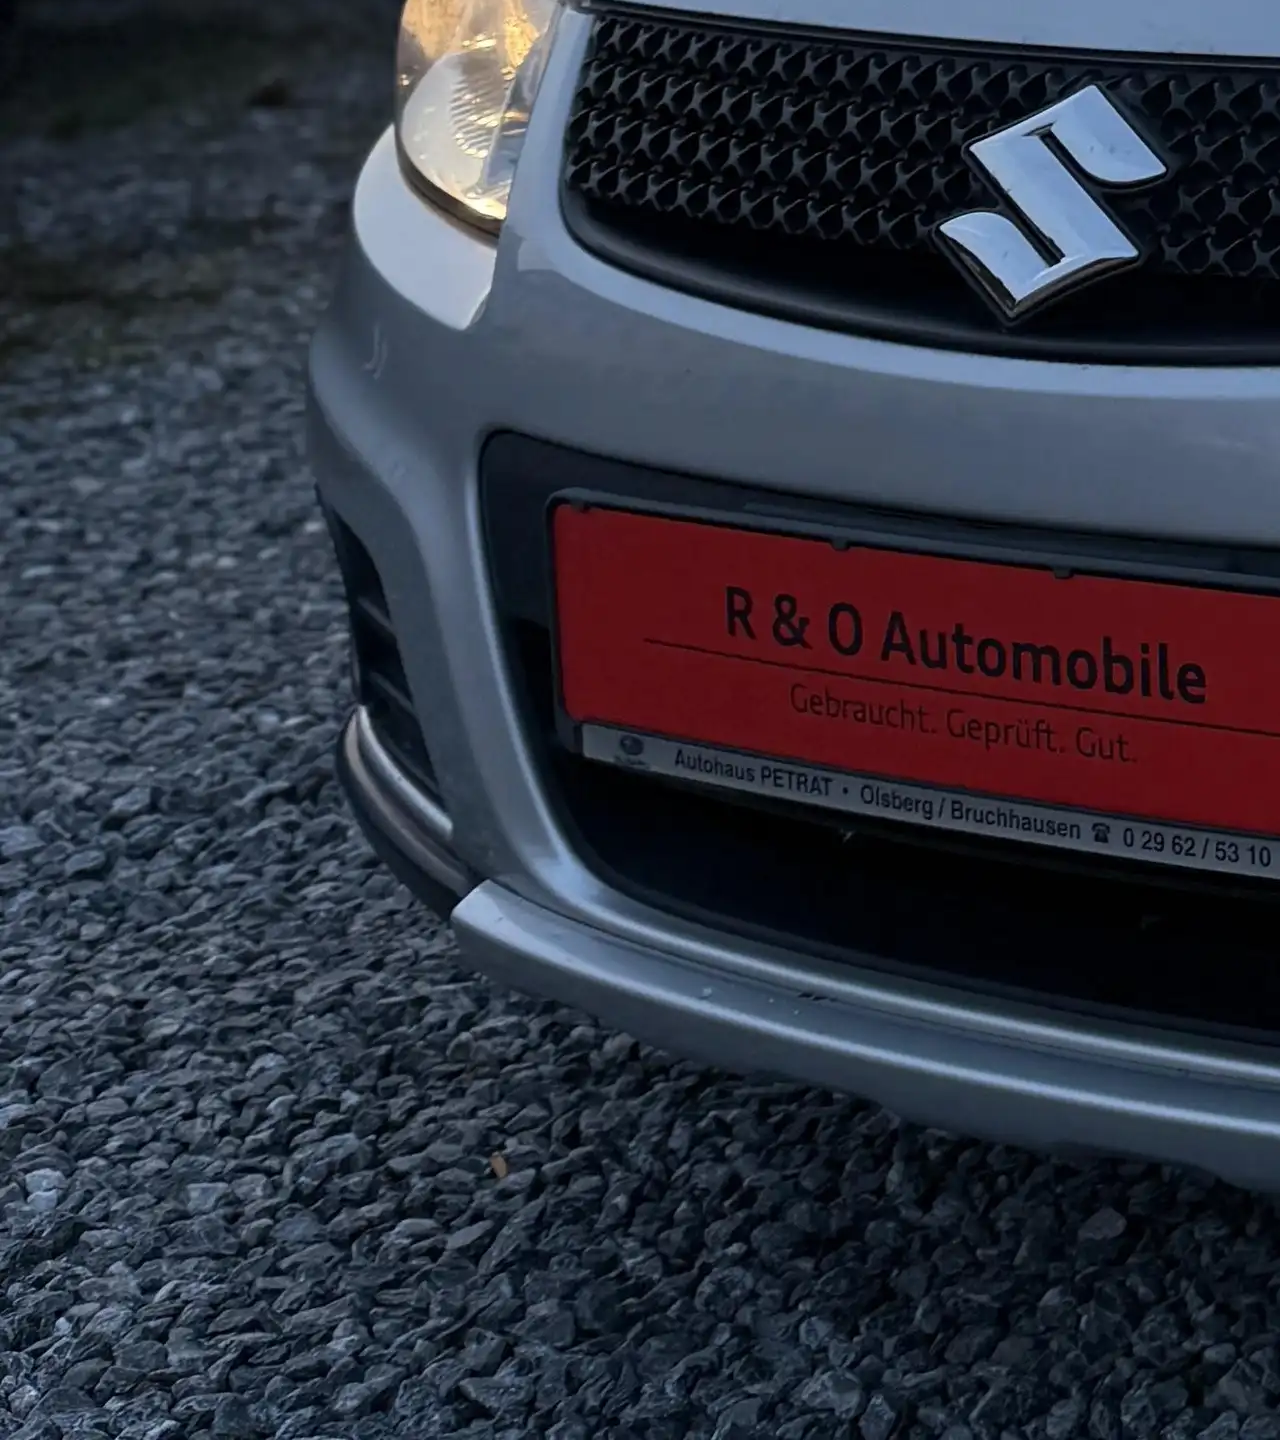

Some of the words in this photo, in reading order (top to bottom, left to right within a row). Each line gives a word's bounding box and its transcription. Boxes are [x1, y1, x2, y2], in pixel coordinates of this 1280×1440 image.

[726, 586, 756, 640] R
[772, 594, 810, 648] &
[828, 602, 864, 657] O
[881, 611, 1207, 704] Automobile
[790, 683, 937, 735] Gebraucht.
[947, 709, 1065, 755] Geprüft.
[1076, 726, 1138, 764] Gut.
[674, 749, 755, 783] Autohaus
[760, 765, 833, 797] PETRAT
[860, 783, 934, 821] Olsberg
[951, 799, 1081, 840] Bruchhausen
[1123, 827, 1135, 848] 0
[1141, 830, 1165, 853] 29
[1171, 835, 1197, 858] 62
[1215, 840, 1241, 864] 53
[1249, 845, 1272, 868] 10
